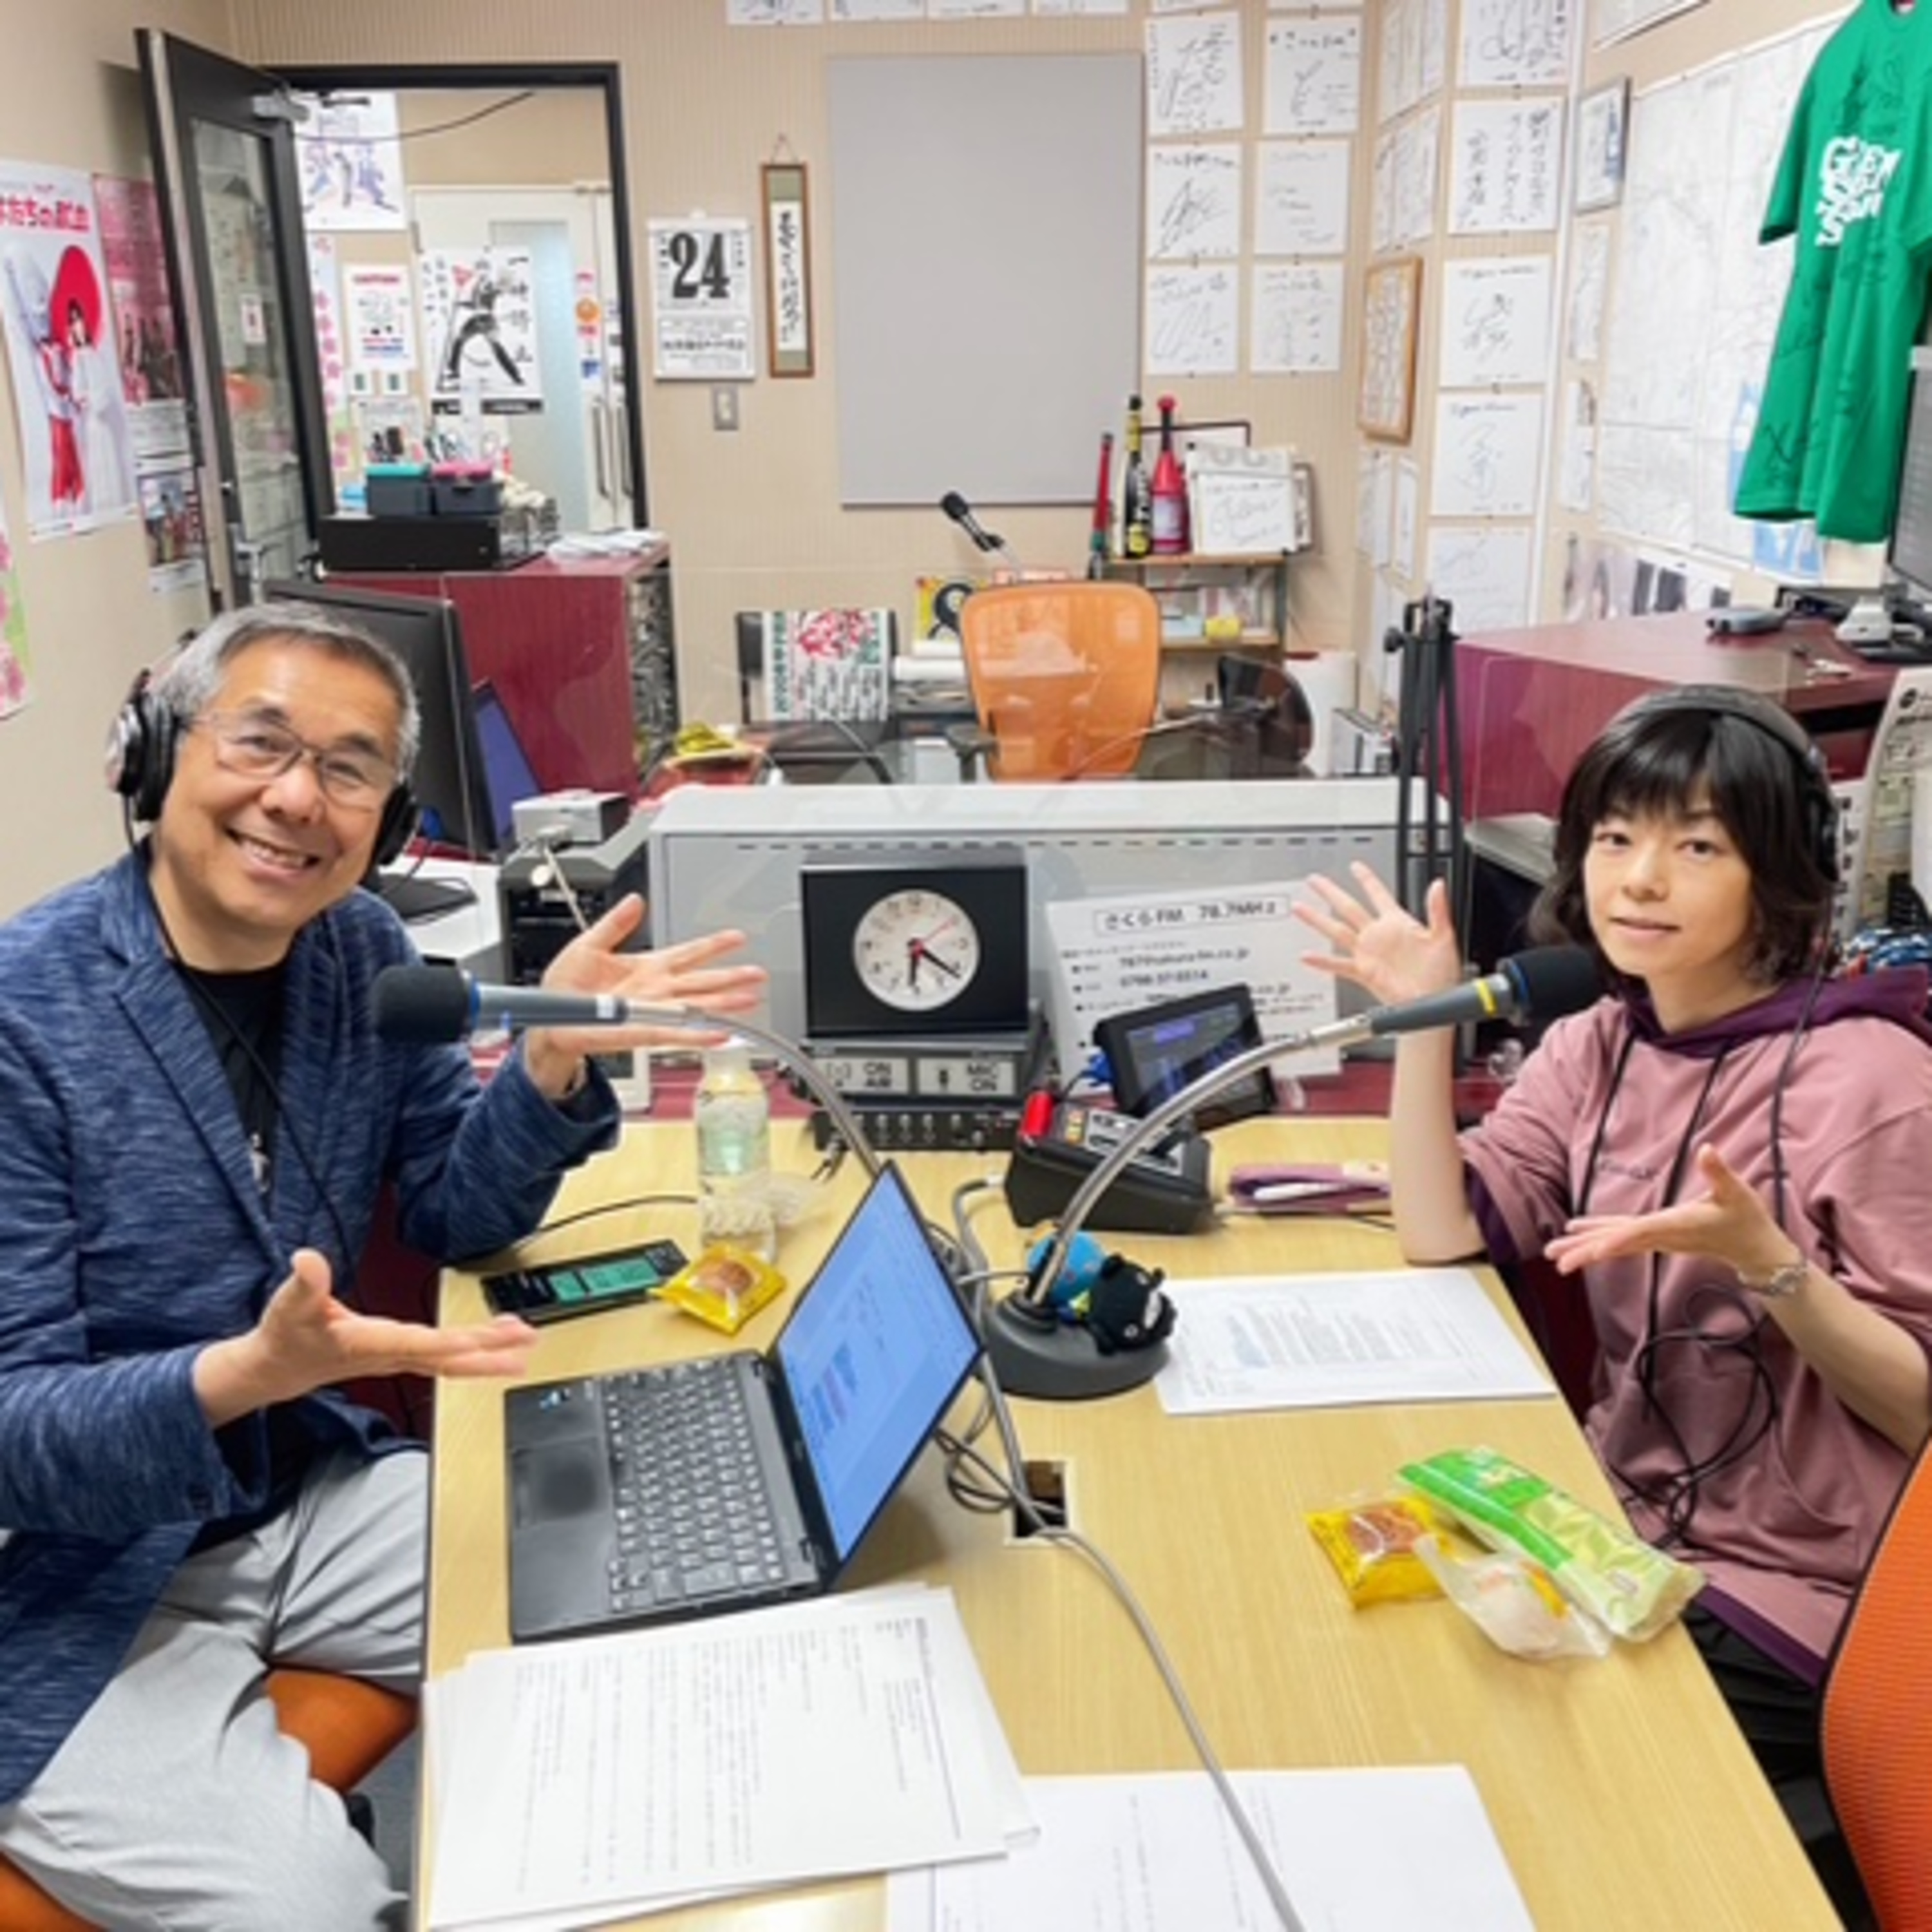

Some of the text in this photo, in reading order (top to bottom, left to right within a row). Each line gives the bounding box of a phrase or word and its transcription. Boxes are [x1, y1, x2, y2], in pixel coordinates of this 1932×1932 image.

[669, 232, 730, 298] 24
[864, 1062, 892, 1075] ON
[967, 1063, 998, 1076] MIC
[970, 1077, 998, 1092] ON
